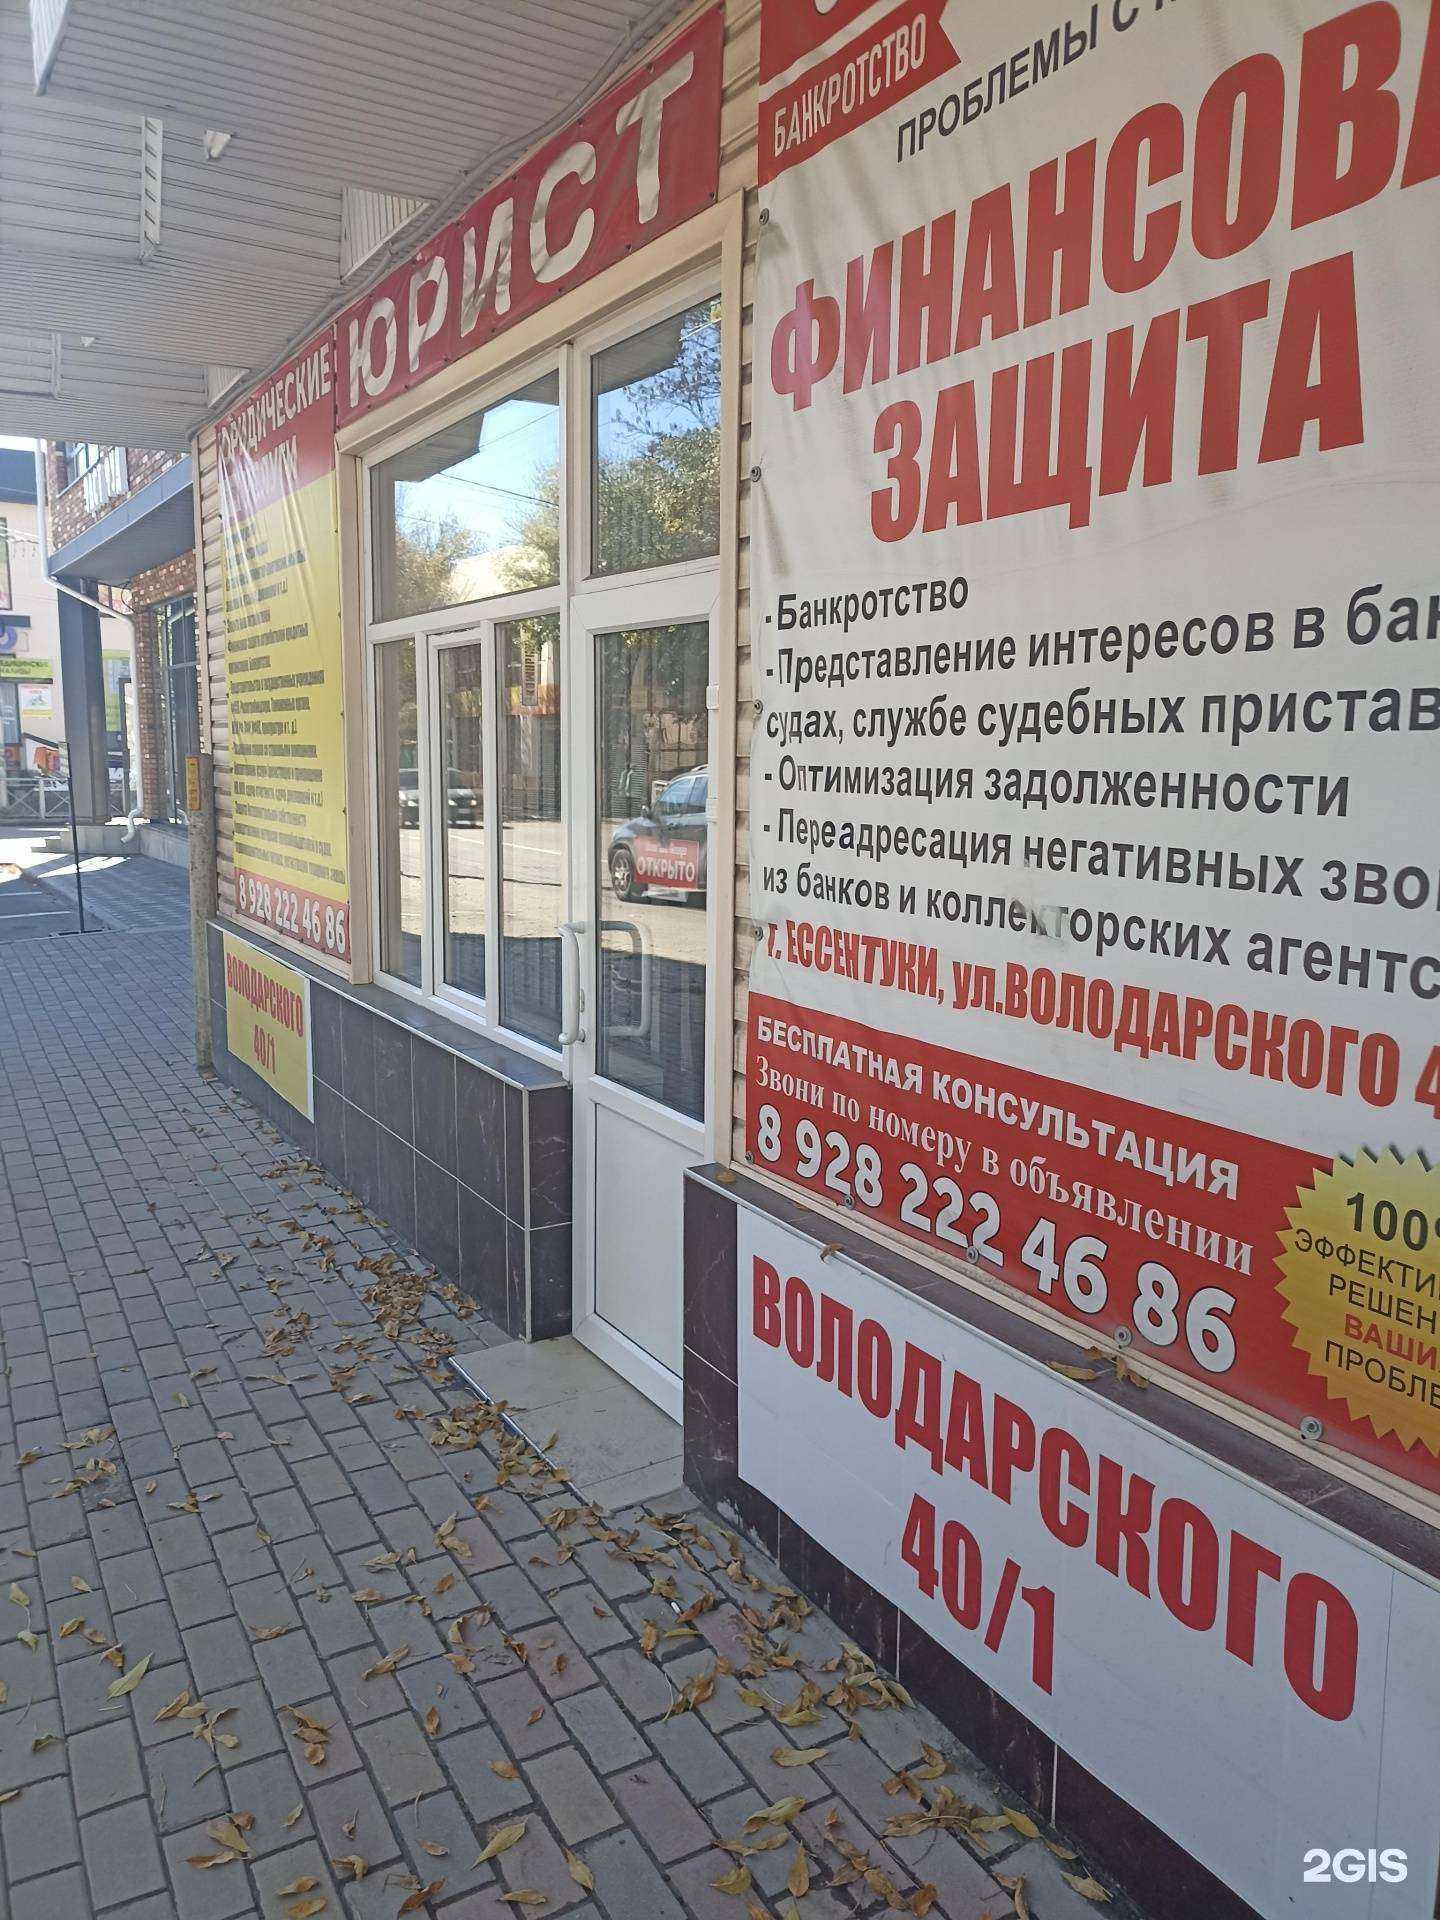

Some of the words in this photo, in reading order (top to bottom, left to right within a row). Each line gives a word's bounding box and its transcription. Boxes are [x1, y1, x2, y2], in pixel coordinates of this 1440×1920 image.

[774, 13, 926, 158] БАНКРОТСТВО
[897, 4, 1098, 163] ПРОБЛЕМЫ
[349, 51, 694, 408] ЮРИСТ
[871, 251, 1365, 544] ЗАЩИТА
[1029, 611, 1274, 673] интересов
[1293, 607, 1325, 649] в
[767, 708, 843, 747] судах,
[853, 694, 966, 747] службе
[978, 687, 1185, 747] судебных
[1201, 688, 1440, 746] пристав
[779, 755, 973, 804] Оптимизация
[984, 768, 1349, 817] задолженности
[636, 856, 695, 882] ОТКРЫТО
[778, 808, 1011, 868] Переадресация
[1024, 836, 1304, 897] негативных
[1320, 860, 1440, 912] зво
[239, 874, 246, 910] 8
[249, 878, 272, 922] 928
[274, 887, 299, 934] 222
[302, 898, 321, 944] 46
[325, 905, 346, 954] 86
[763, 866, 787, 894] из
[797, 862, 889, 910] банков
[899, 885, 916, 914] и
[1247, 932, 1440, 999] агентс
[226, 952, 304, 1038] ВОЛОДАРСКОГО
[786, 919, 944, 1005] ЕССЕНТУКИ,
[253, 1024, 276, 1075] 40/1
[758, 1015, 923, 1094] БЕСПЛАТНАЯ
[932, 1071, 1239, 1200] КОНСУЛЬТАЦИЯ
[755, 1056, 824, 1108] Звони
[832, 1091, 860, 1122] по
[869, 1105, 972, 1173] номеру
[982, 1146, 1000, 1175] в
[1010, 1155, 1254, 1276] объявлении
[757, 1103, 782, 1162] 8
[796, 1118, 883, 1208] 928
[900, 1162, 1004, 1267] 222
[1021, 1216, 1108, 1314] 46
[1132, 1261, 1237, 1373] 86
[1294, 1228, 1440, 1298] ЭФФЕКТИ
[1347, 1192, 1440, 1251] 100
[1329, 1274, 1437, 1334] РЕШЕН
[1344, 1313, 1440, 1372] ВАШИ
[752, 1255, 1359, 1721] ВОЛОДАРСКОГО
[901, 1493, 1056, 1695] 40/1
